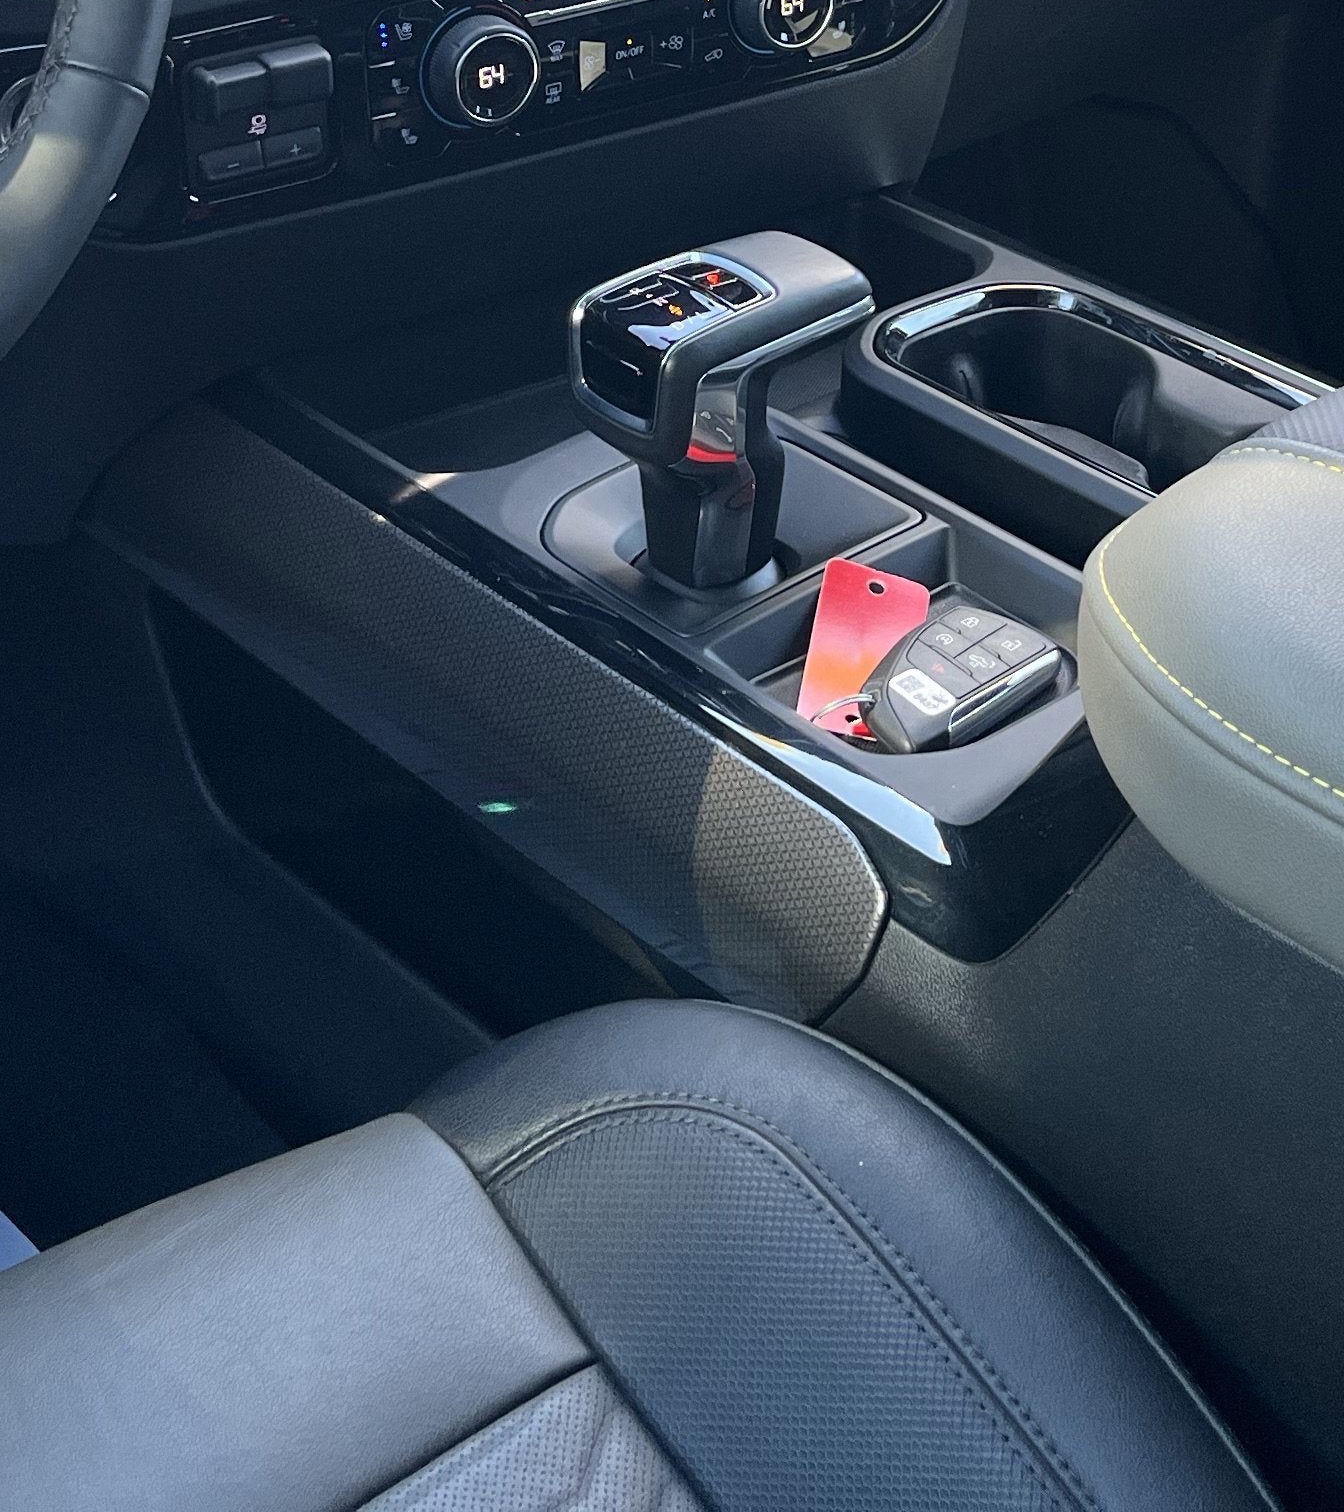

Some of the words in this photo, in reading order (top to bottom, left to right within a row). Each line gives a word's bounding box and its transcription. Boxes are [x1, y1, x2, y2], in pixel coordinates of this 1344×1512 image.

[702, 7, 716, 20] A/C
[615, 44, 645, 61] ON/OFF
[478, 62, 505, 90] 64
